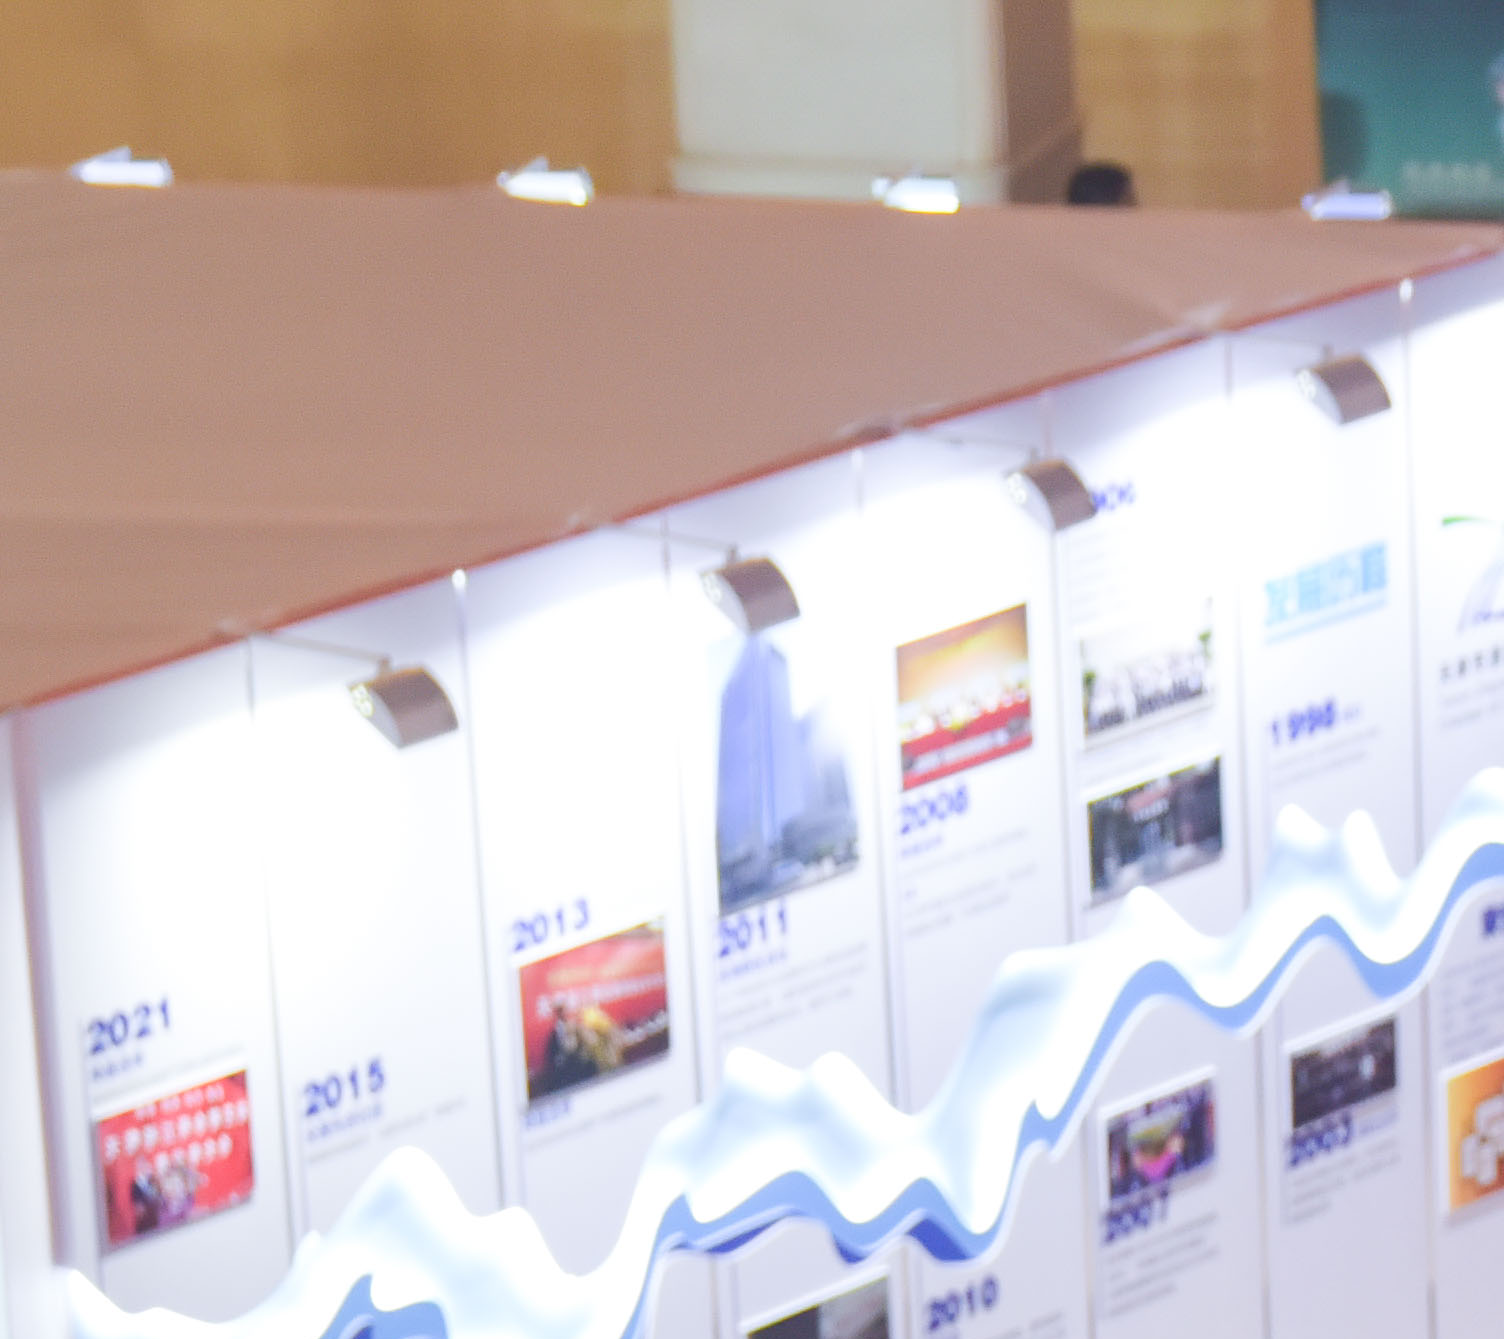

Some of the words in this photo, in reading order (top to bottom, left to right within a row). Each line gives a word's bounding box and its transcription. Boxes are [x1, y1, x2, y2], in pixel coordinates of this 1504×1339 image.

[512, 896, 589, 952] 2013
[719, 896, 787, 958] 2011
[88, 995, 171, 1056] 2021
[305, 1056, 386, 1117] 2015
[929, 1276, 999, 1332] 2010
